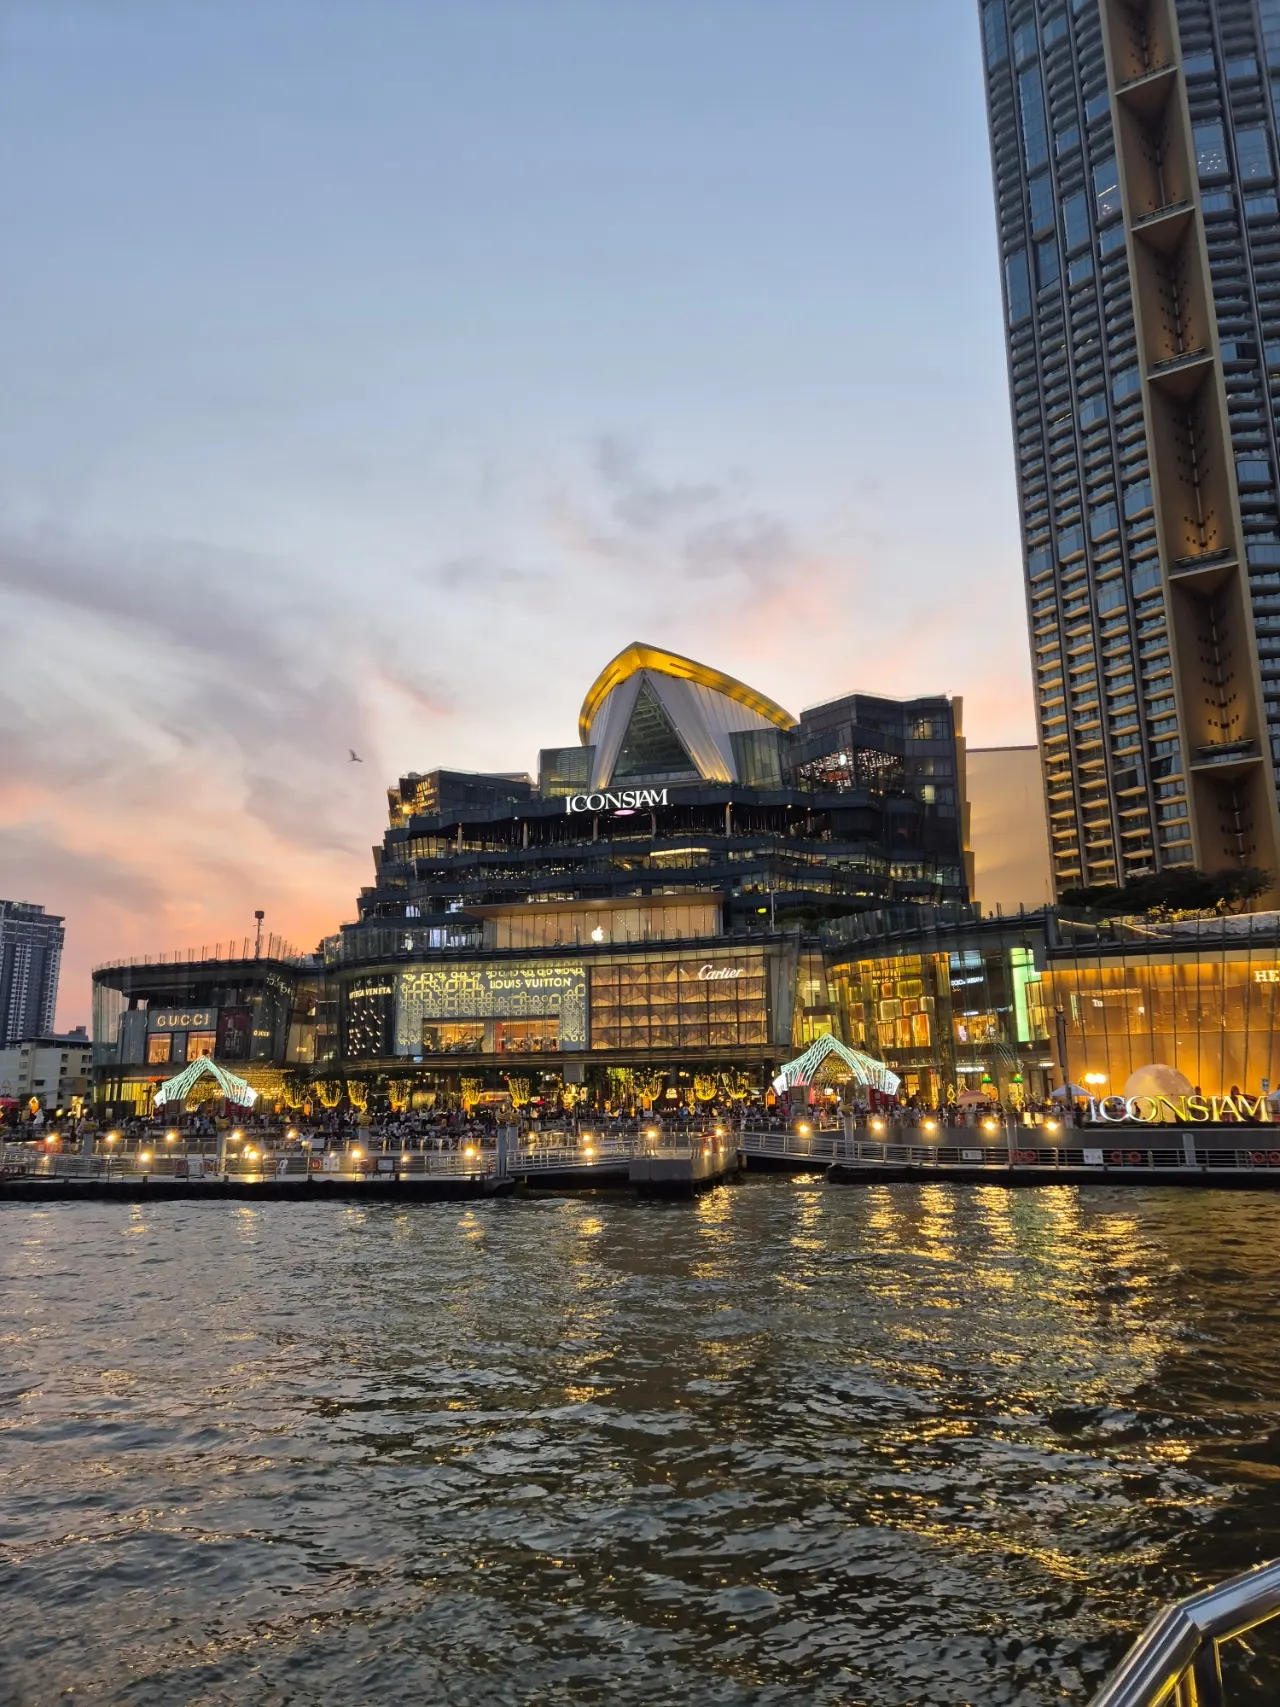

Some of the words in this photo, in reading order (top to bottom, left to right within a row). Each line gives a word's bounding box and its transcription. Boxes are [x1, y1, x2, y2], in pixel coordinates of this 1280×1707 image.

[565, 788, 668, 813] ICONSIAM
[698, 964, 743, 980] Cartier
[490, 979, 521, 989] LOUIS
[525, 977, 572, 988] VUITTON
[365, 986, 392, 996] VENETA
[157, 1013, 210, 1027] GUCCI
[1087, 1095, 1270, 1122] ICONSIAM
